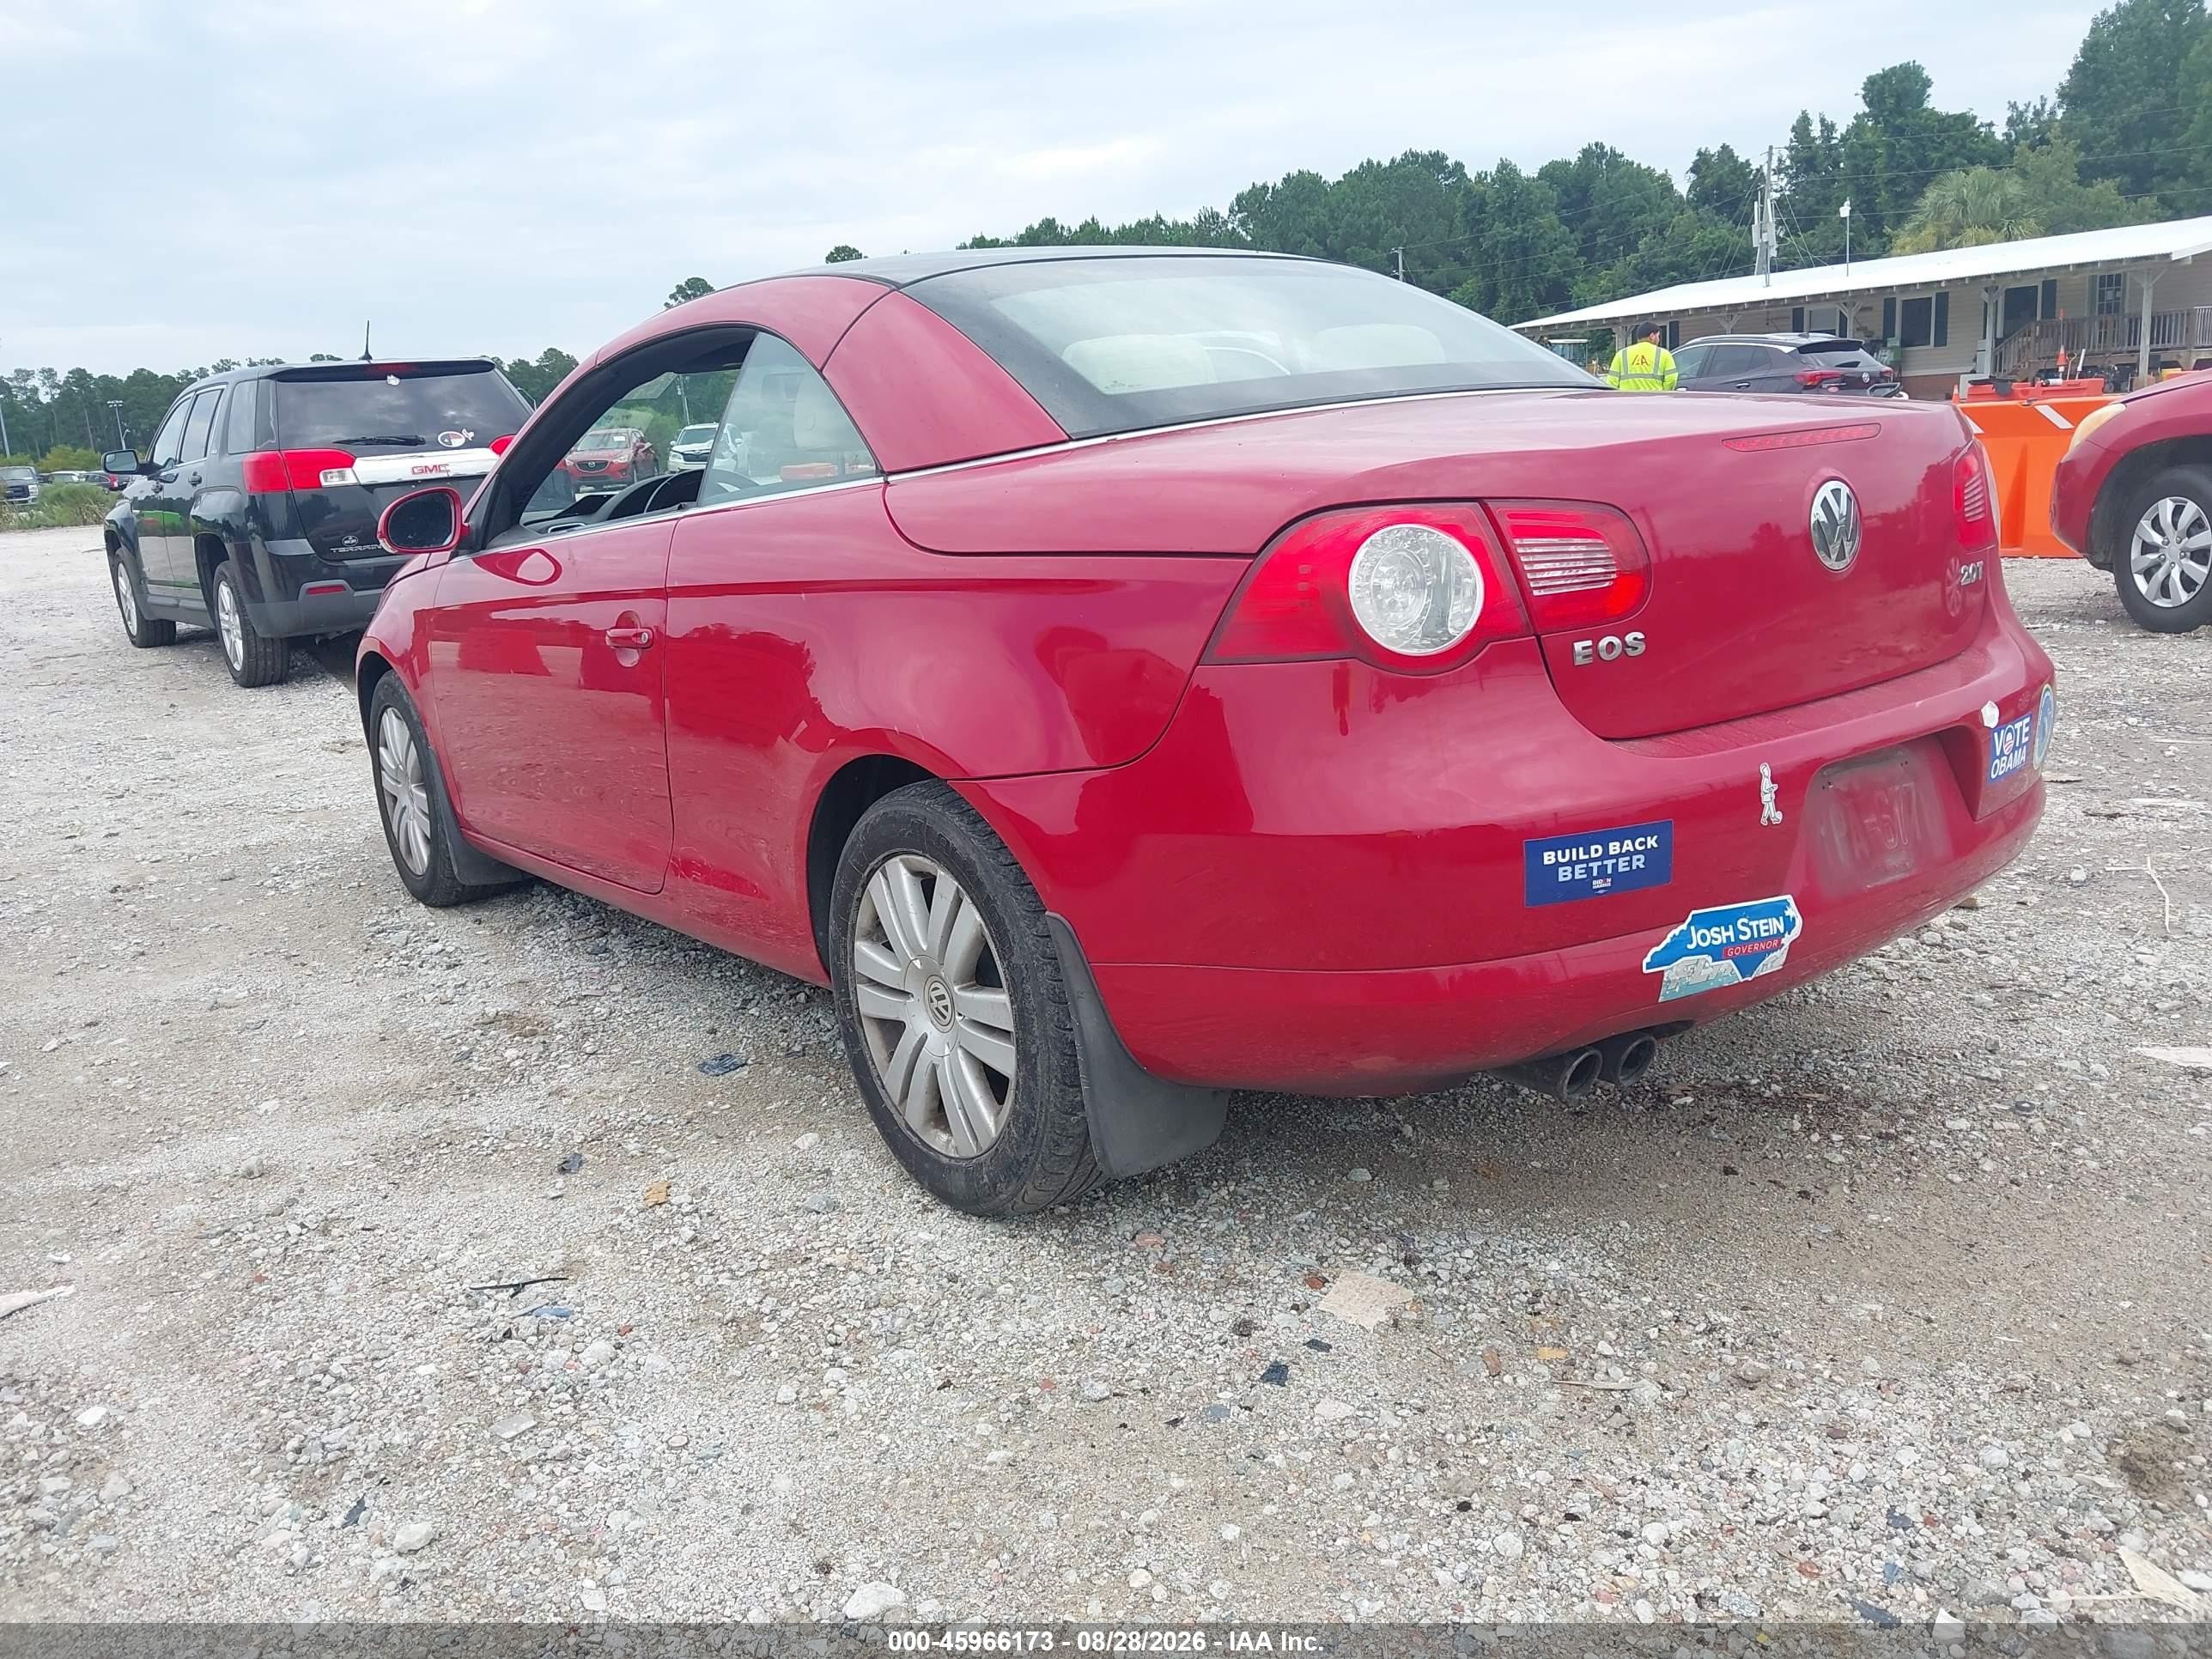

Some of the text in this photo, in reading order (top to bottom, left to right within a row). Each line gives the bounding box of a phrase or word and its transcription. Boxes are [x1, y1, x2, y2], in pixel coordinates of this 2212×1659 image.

[411, 463, 450, 475] GMC
[1572, 631, 1646, 666] EOS
[1993, 716, 2032, 757] VOTE
[1990, 745, 2027, 780] OBAMA
[1542, 835, 1659, 866] BUILD BACK
[1558, 854, 1645, 883] BETTER
[1686, 915, 1785, 950] JOSH STEIN
[1727, 939, 1778, 957] GOVERNOR
